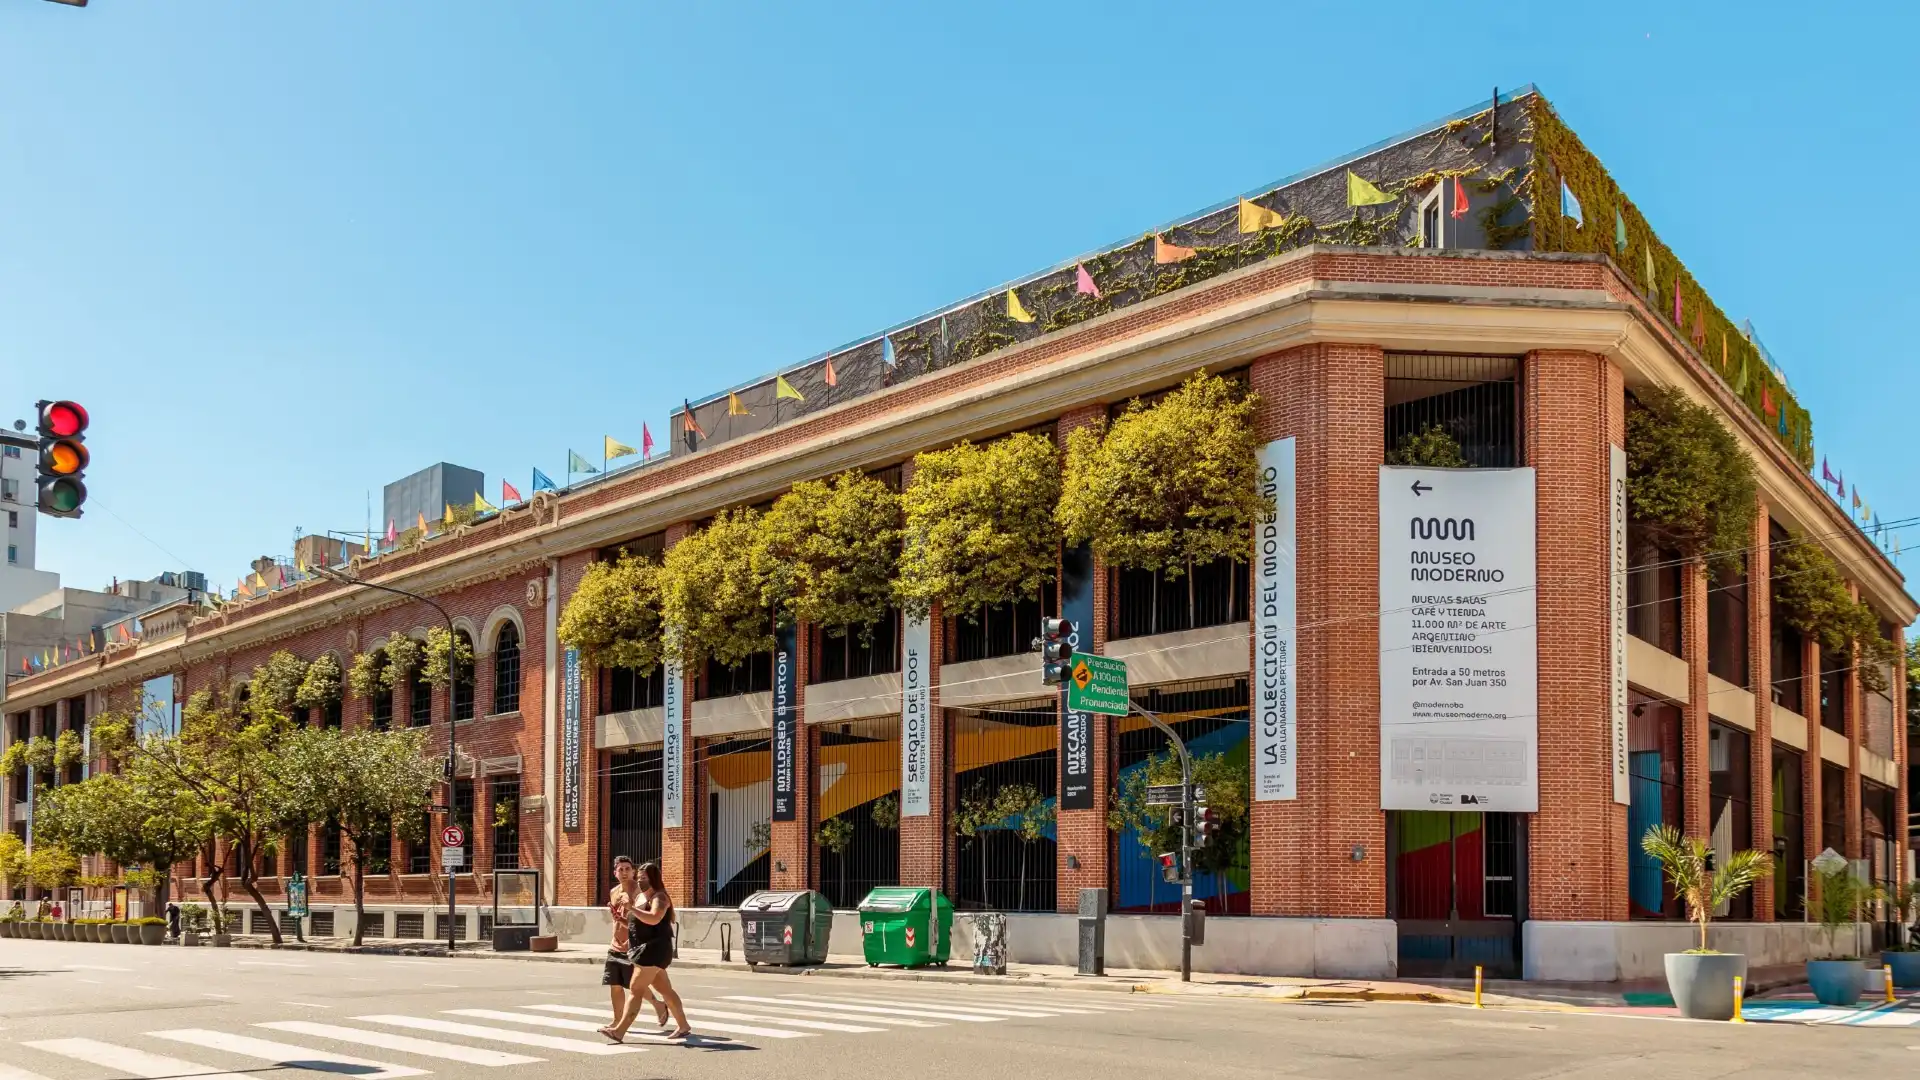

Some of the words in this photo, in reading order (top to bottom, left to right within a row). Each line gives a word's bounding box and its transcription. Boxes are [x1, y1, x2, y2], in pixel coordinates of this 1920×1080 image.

[1411, 551, 1476, 565] MUSEO
[1411, 568, 1504, 583] MODERNO
[1264, 581, 1277, 618] DEL
[1411, 595, 1454, 604] NUEVAS
[1455, 596, 1487, 605] SALAS
[1411, 606, 1436, 616] CAFÉ
[1438, 608, 1445, 616] Y
[1446, 608, 1486, 617] TIENDA
[1411, 620, 1445, 629] 11.000
[1465, 621, 1478, 629] DE
[1481, 621, 1507, 630] ARTE
[1411, 632, 1476, 643] ARGENTINO
[1412, 644, 1492, 654] ¡BIENVENIDOS!
[908, 648, 918, 690] LOOF
[1412, 667, 1448, 676] Entrada
[1459, 668, 1471, 677] 50
[1472, 668, 1506, 677] metros
[777, 651, 788, 716] BURTON
[1261, 624, 1277, 738] COLECCIÓN
[1412, 679, 1427, 687] por
[1429, 678, 1443, 686] Av.
[1446, 678, 1463, 686] San
[1465, 678, 1487, 687] Juan
[1489, 679, 1507, 687] 350
[1091, 683, 1128, 697] Pendiente
[908, 694, 918, 718] DE
[1080, 696, 1128, 711] Pronunciada
[1412, 701, 1464, 709] @modernoba
[777, 719, 788, 792] MILDRED
[908, 720, 920, 783] SERGIO
[1264, 743, 1278, 766] LA
[667, 723, 676, 801] SANTIAGO
